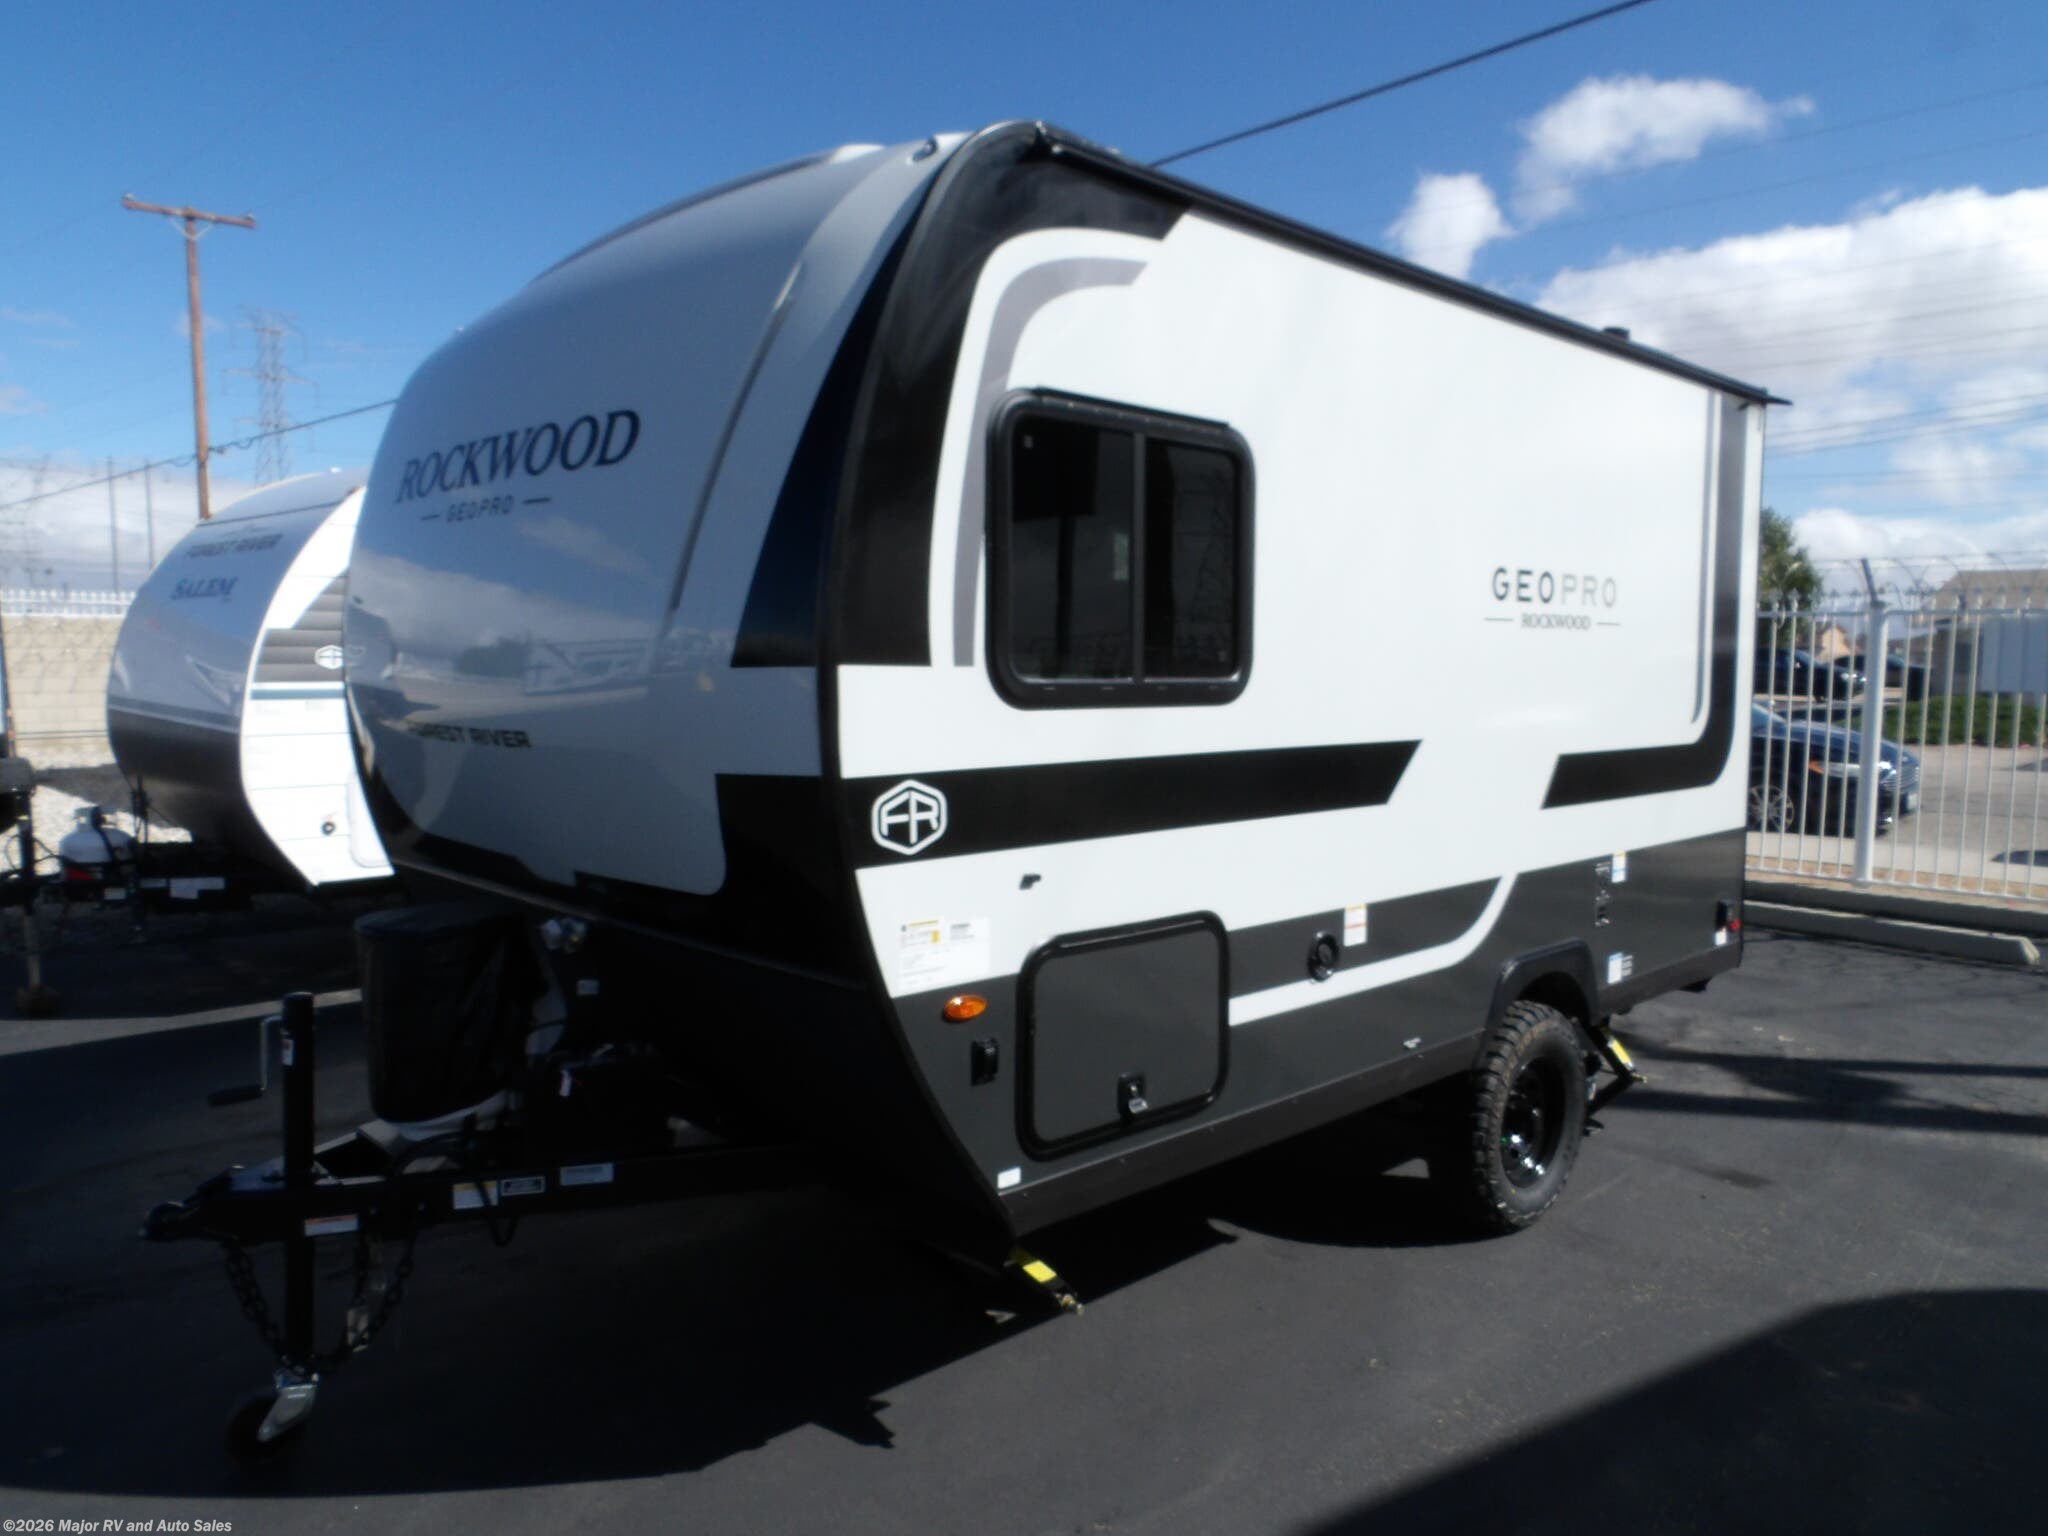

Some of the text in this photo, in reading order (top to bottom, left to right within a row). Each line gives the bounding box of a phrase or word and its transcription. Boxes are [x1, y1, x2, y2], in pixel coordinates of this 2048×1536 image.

[396, 409, 641, 504] ROCKWOOD
[447, 495, 514, 522] GEOPRO
[170, 577, 238, 600] SALEM
[1492, 566, 1618, 608] GEOPRO
[1521, 613, 1592, 630] ROCKWOOD
[468, 728, 532, 749] RIVER
